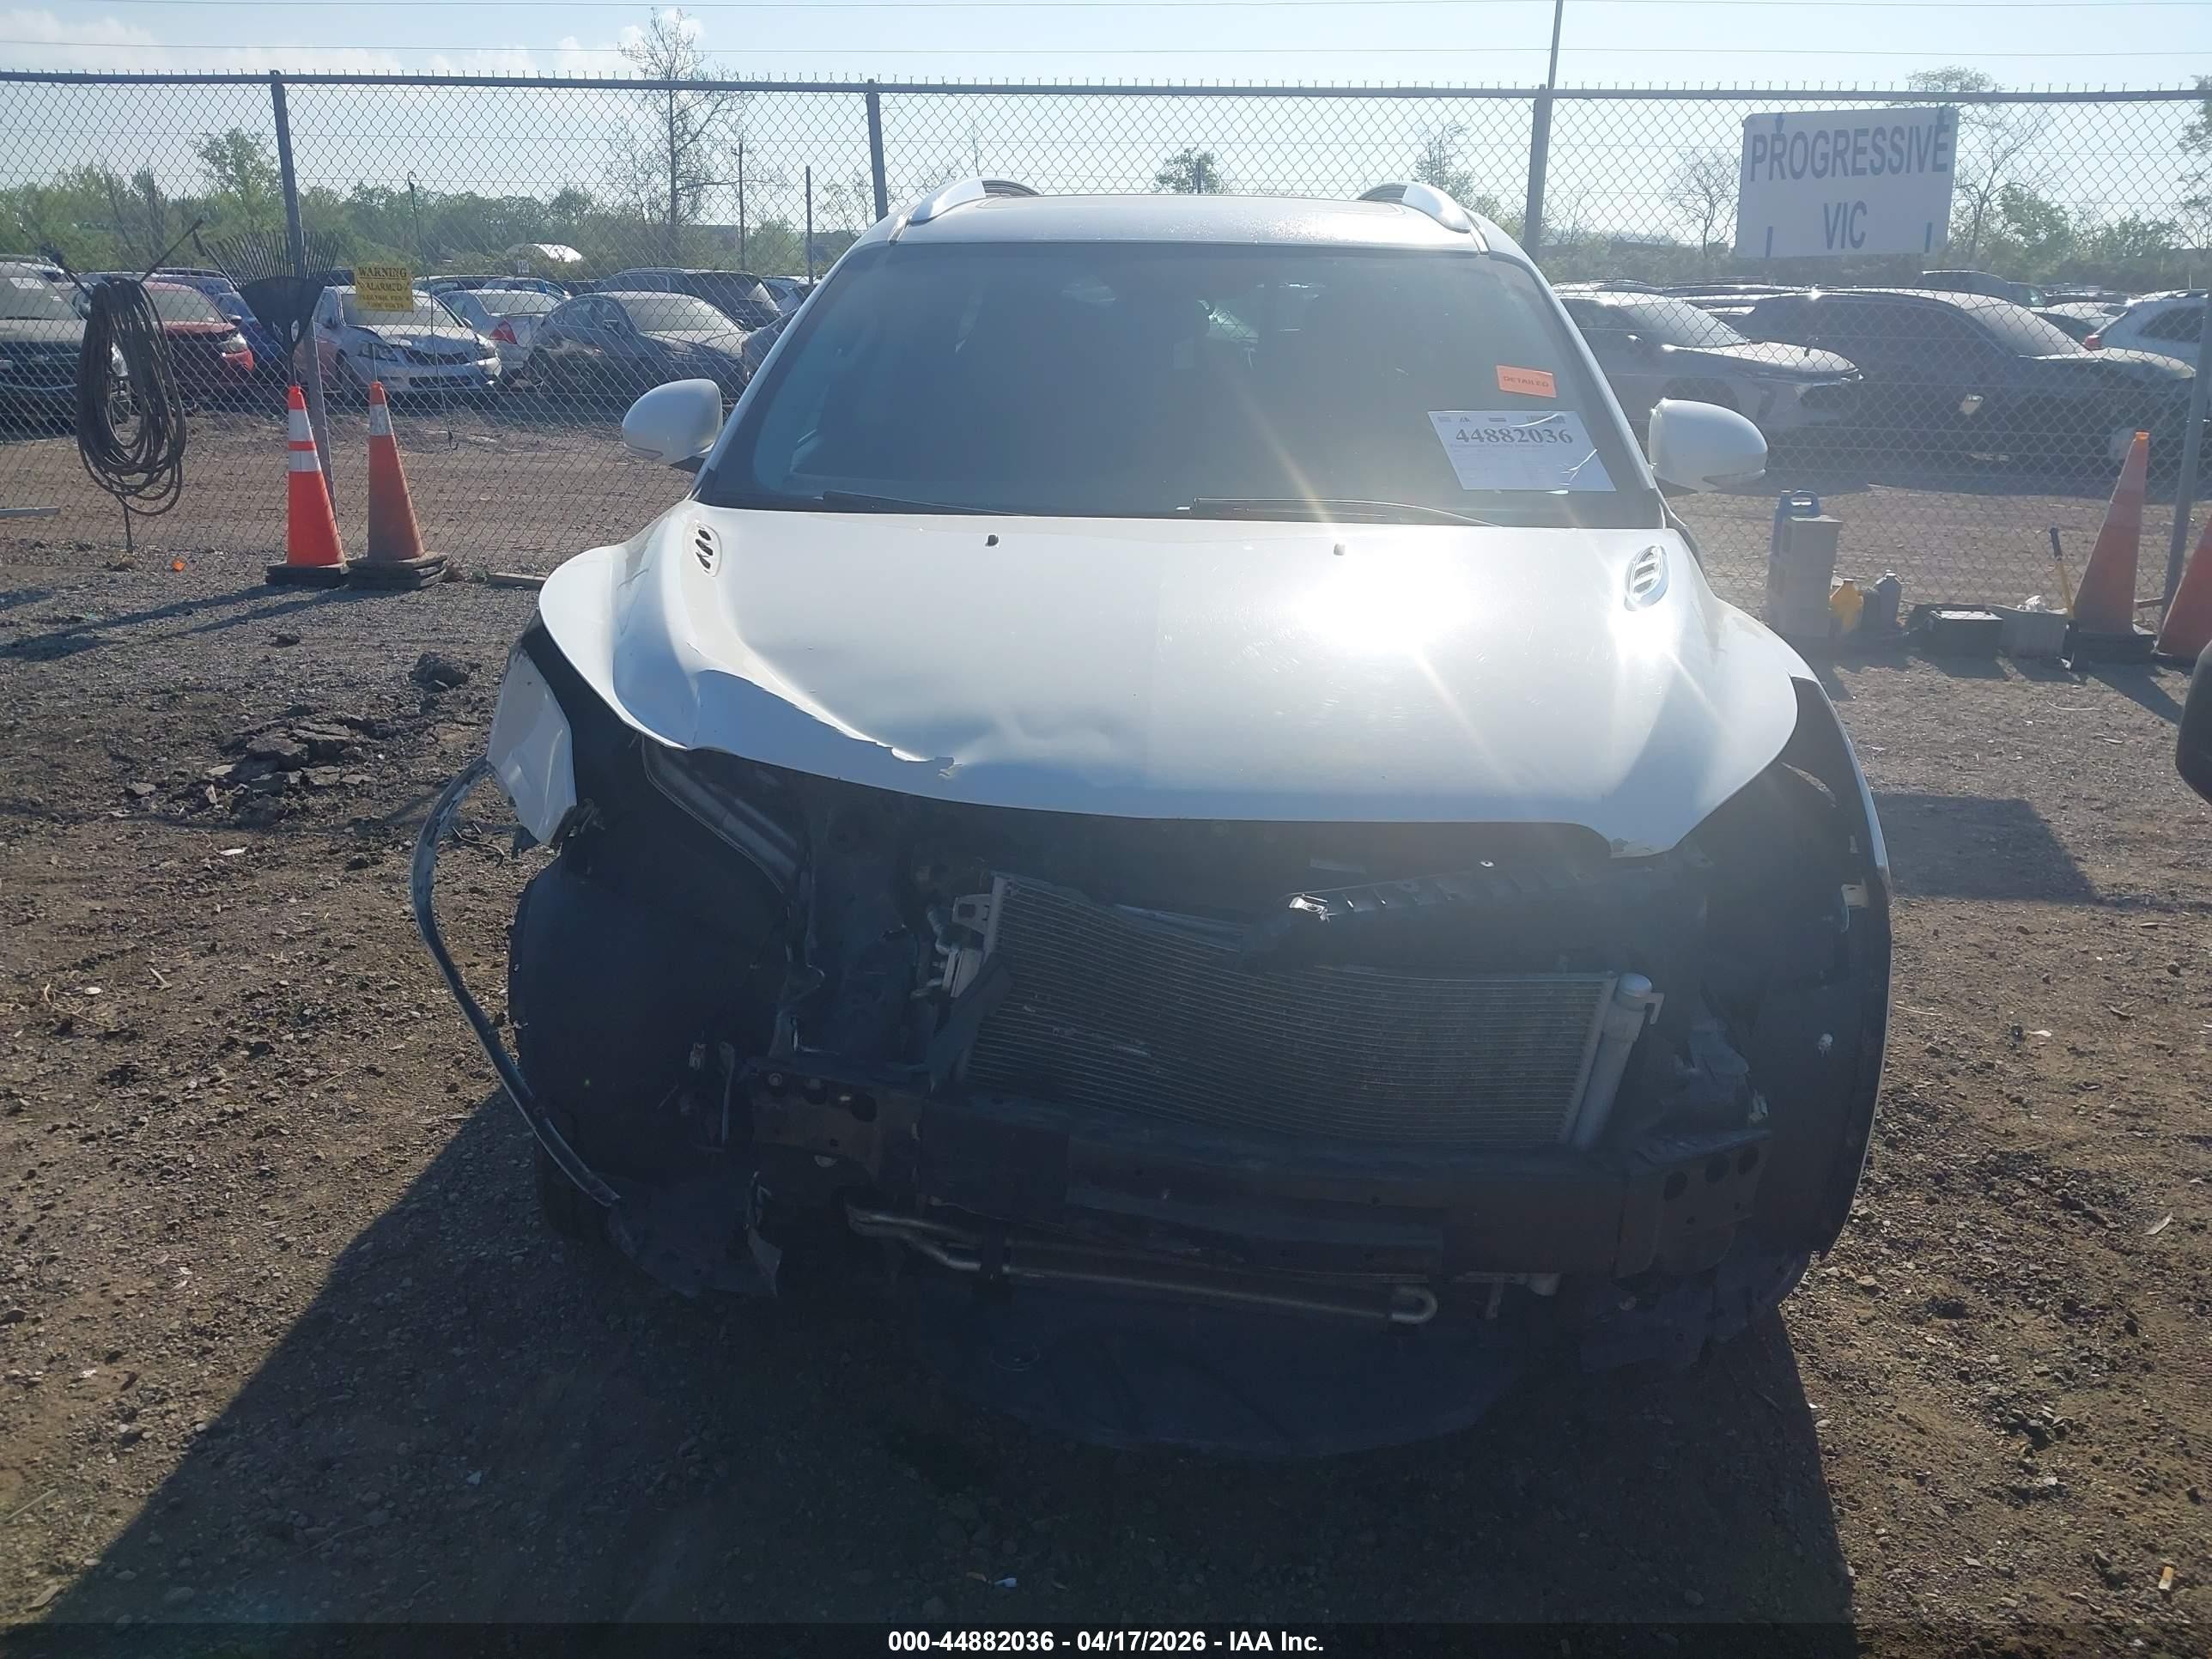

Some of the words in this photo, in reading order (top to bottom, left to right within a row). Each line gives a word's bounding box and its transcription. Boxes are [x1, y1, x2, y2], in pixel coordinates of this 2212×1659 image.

[1750, 124, 1950, 181] PROGRESSIVE
[1823, 200, 1868, 250] VIC
[357, 267, 407, 277] WARNING
[1503, 375, 1549, 387] DETAILED
[1455, 428, 1573, 444] 44882036
